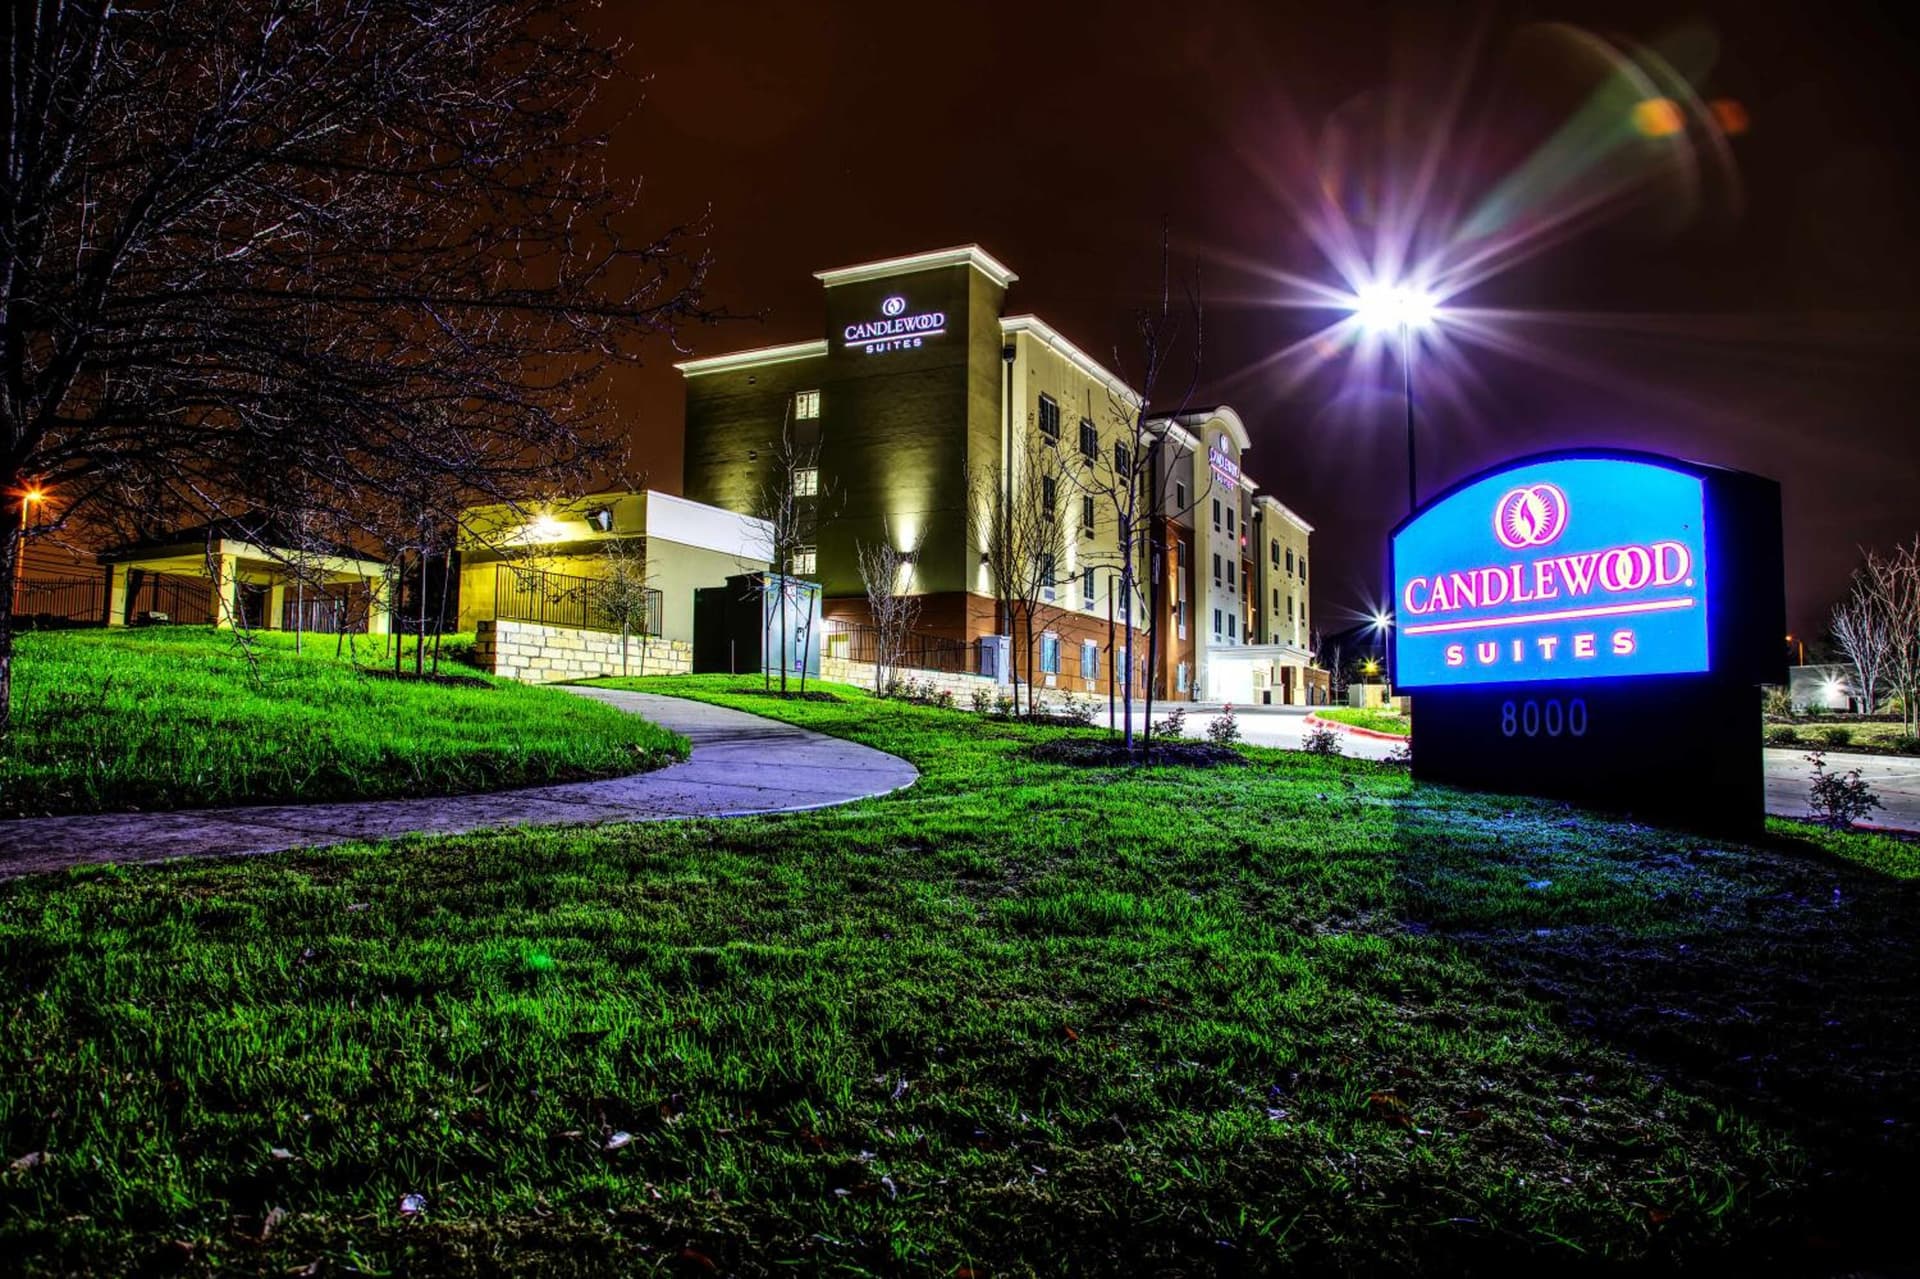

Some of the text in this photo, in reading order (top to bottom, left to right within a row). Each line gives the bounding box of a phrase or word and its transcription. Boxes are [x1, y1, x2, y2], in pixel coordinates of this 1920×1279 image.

[845, 313, 945, 340] CANDLEWOOD
[866, 338, 922, 353] SUITES
[1446, 630, 1636, 666] SUITES
[1501, 699, 1588, 737] 8000
